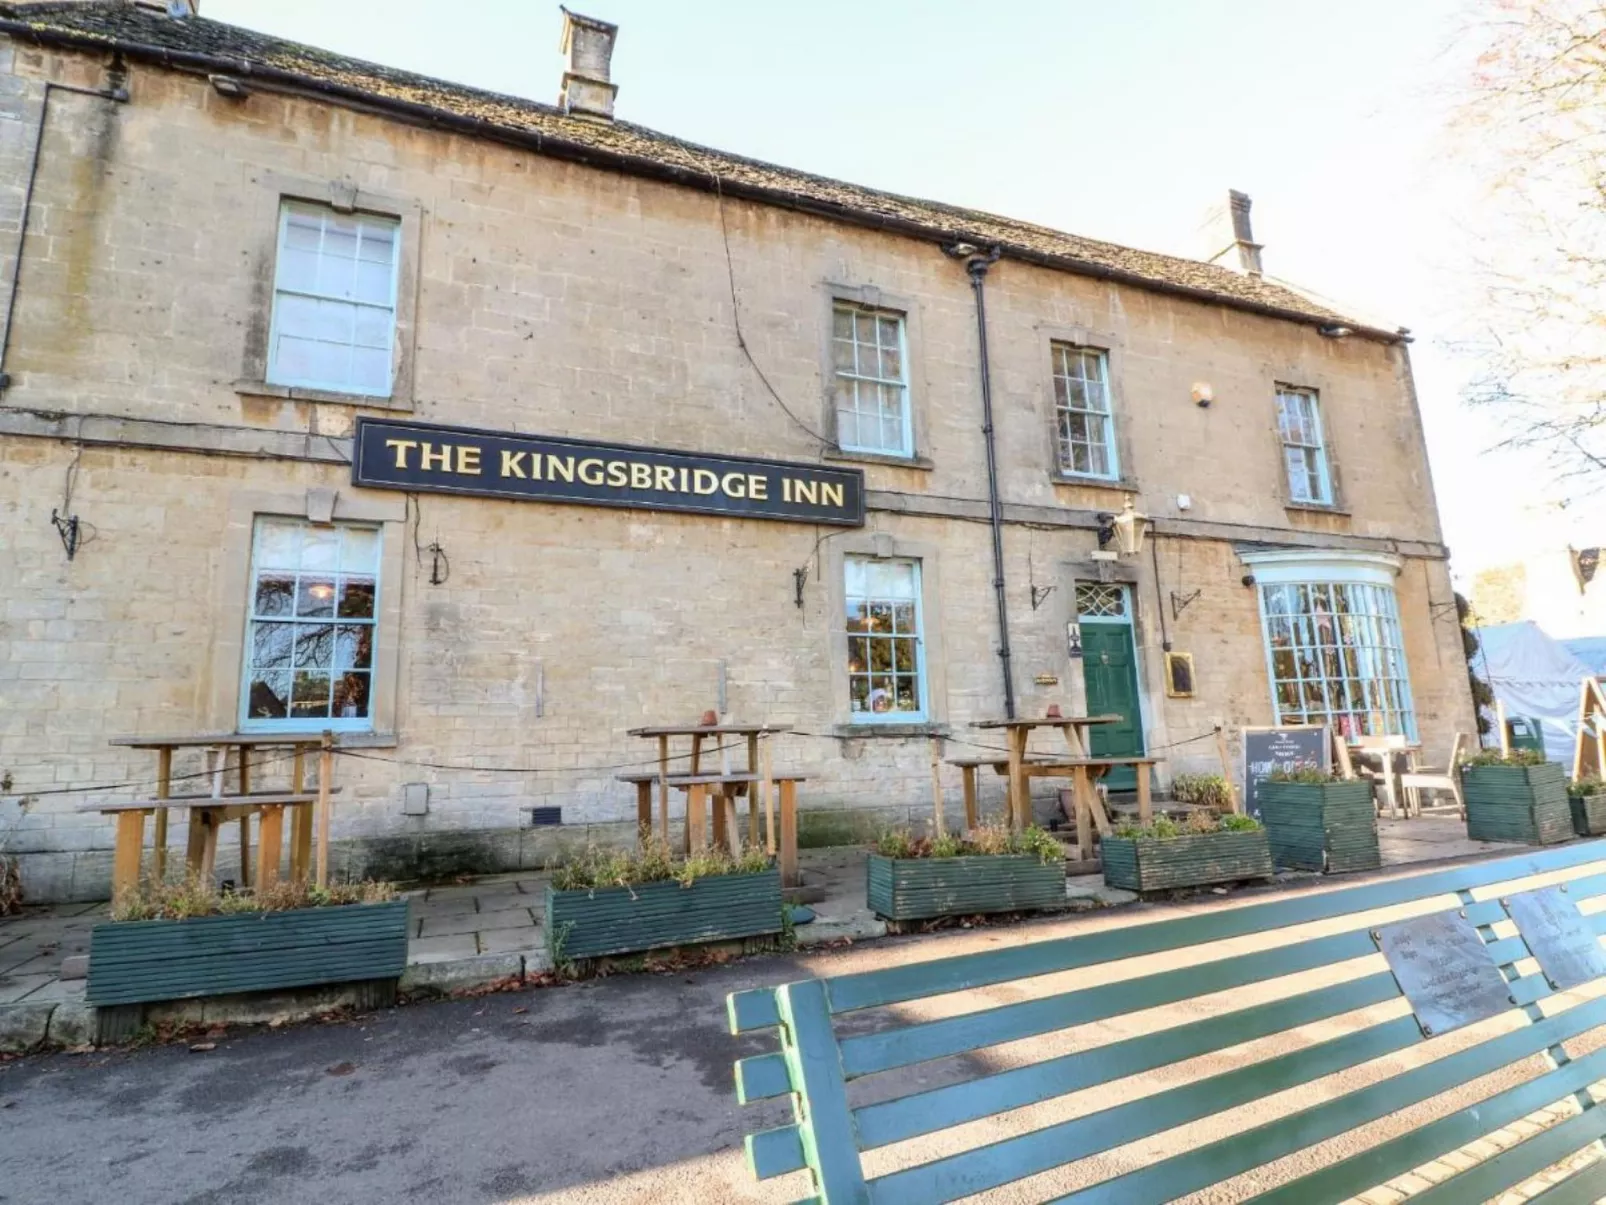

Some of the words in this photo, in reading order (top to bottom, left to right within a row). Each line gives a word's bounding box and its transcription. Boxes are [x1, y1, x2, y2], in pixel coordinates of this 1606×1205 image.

[386, 439, 481, 475] THE
[500, 450, 768, 500] KINGSBRIDGE
[782, 477, 844, 507] INN
